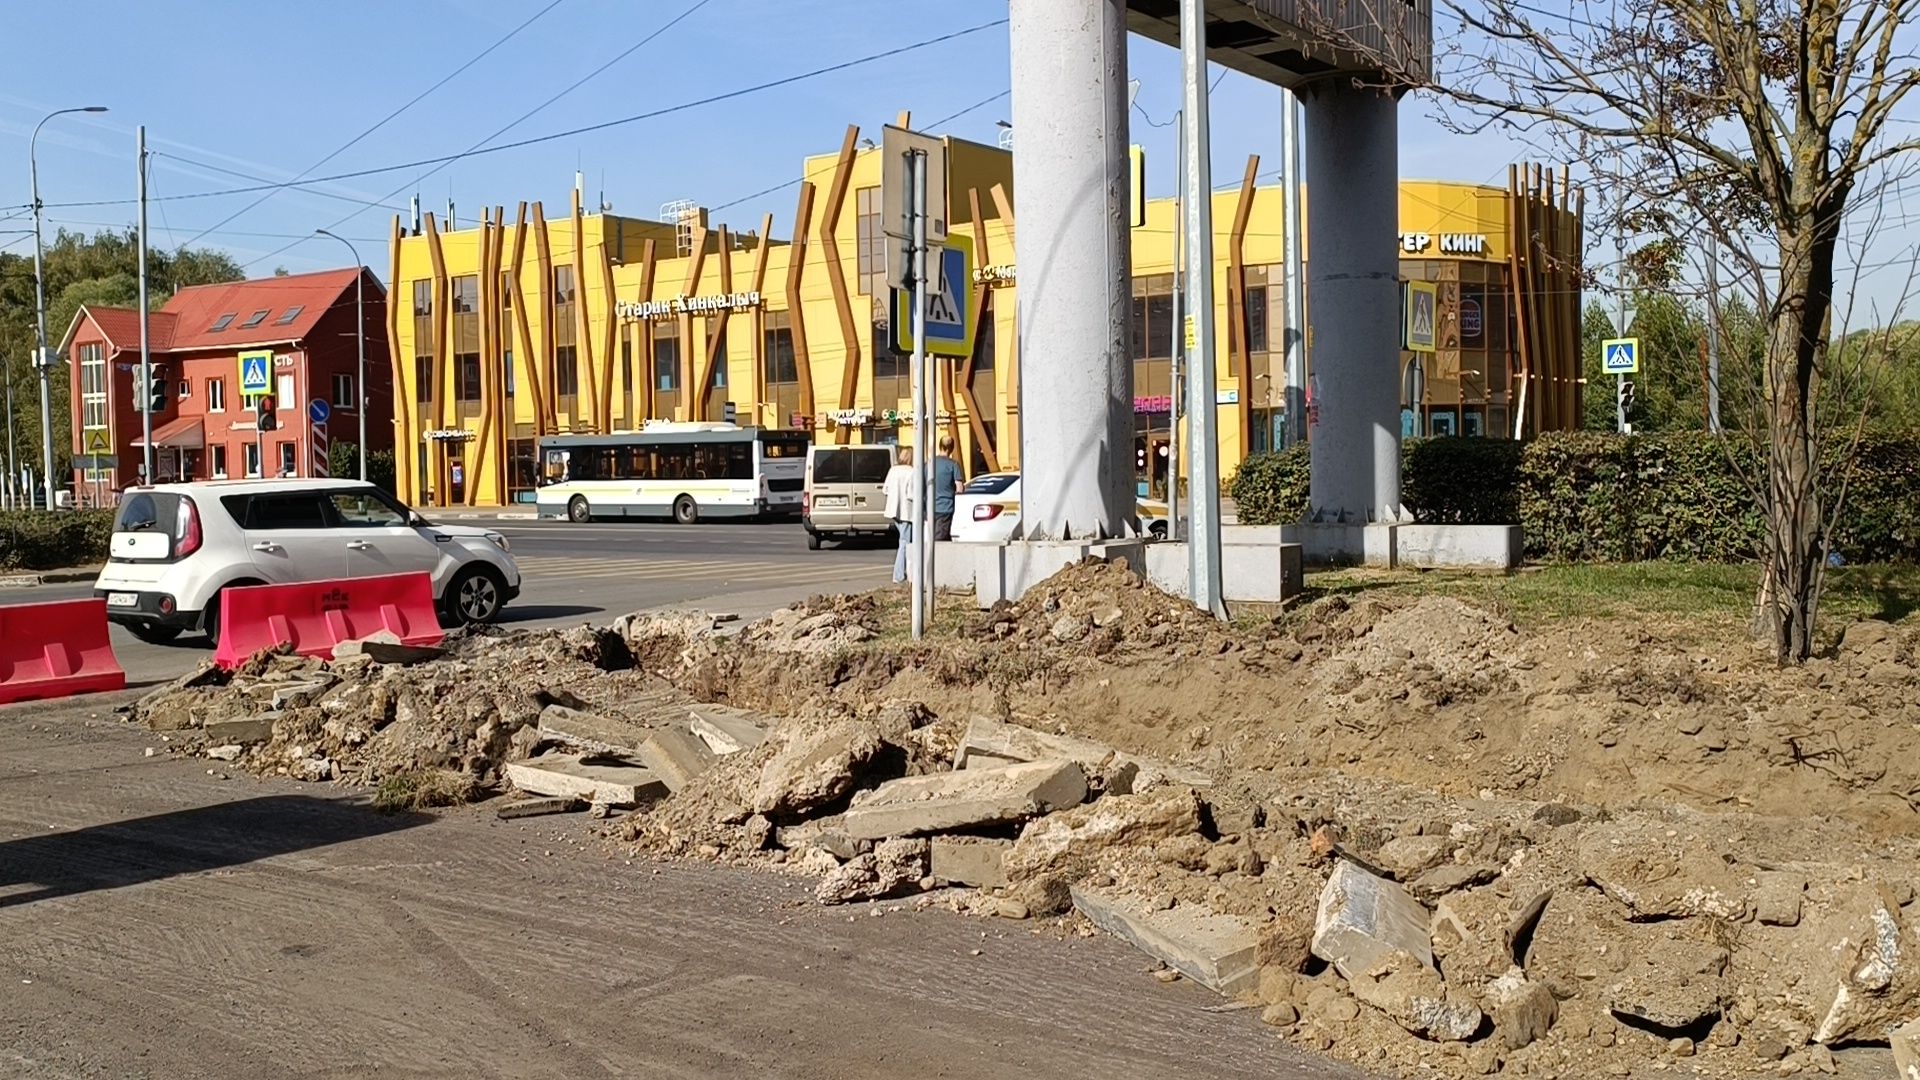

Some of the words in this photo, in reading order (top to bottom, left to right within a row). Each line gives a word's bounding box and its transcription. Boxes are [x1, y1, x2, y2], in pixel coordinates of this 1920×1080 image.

[1440, 232, 1486, 252] КИНГ
[615, 300, 671, 319] Старик
[675, 291, 759, 312] Хинкалыч
